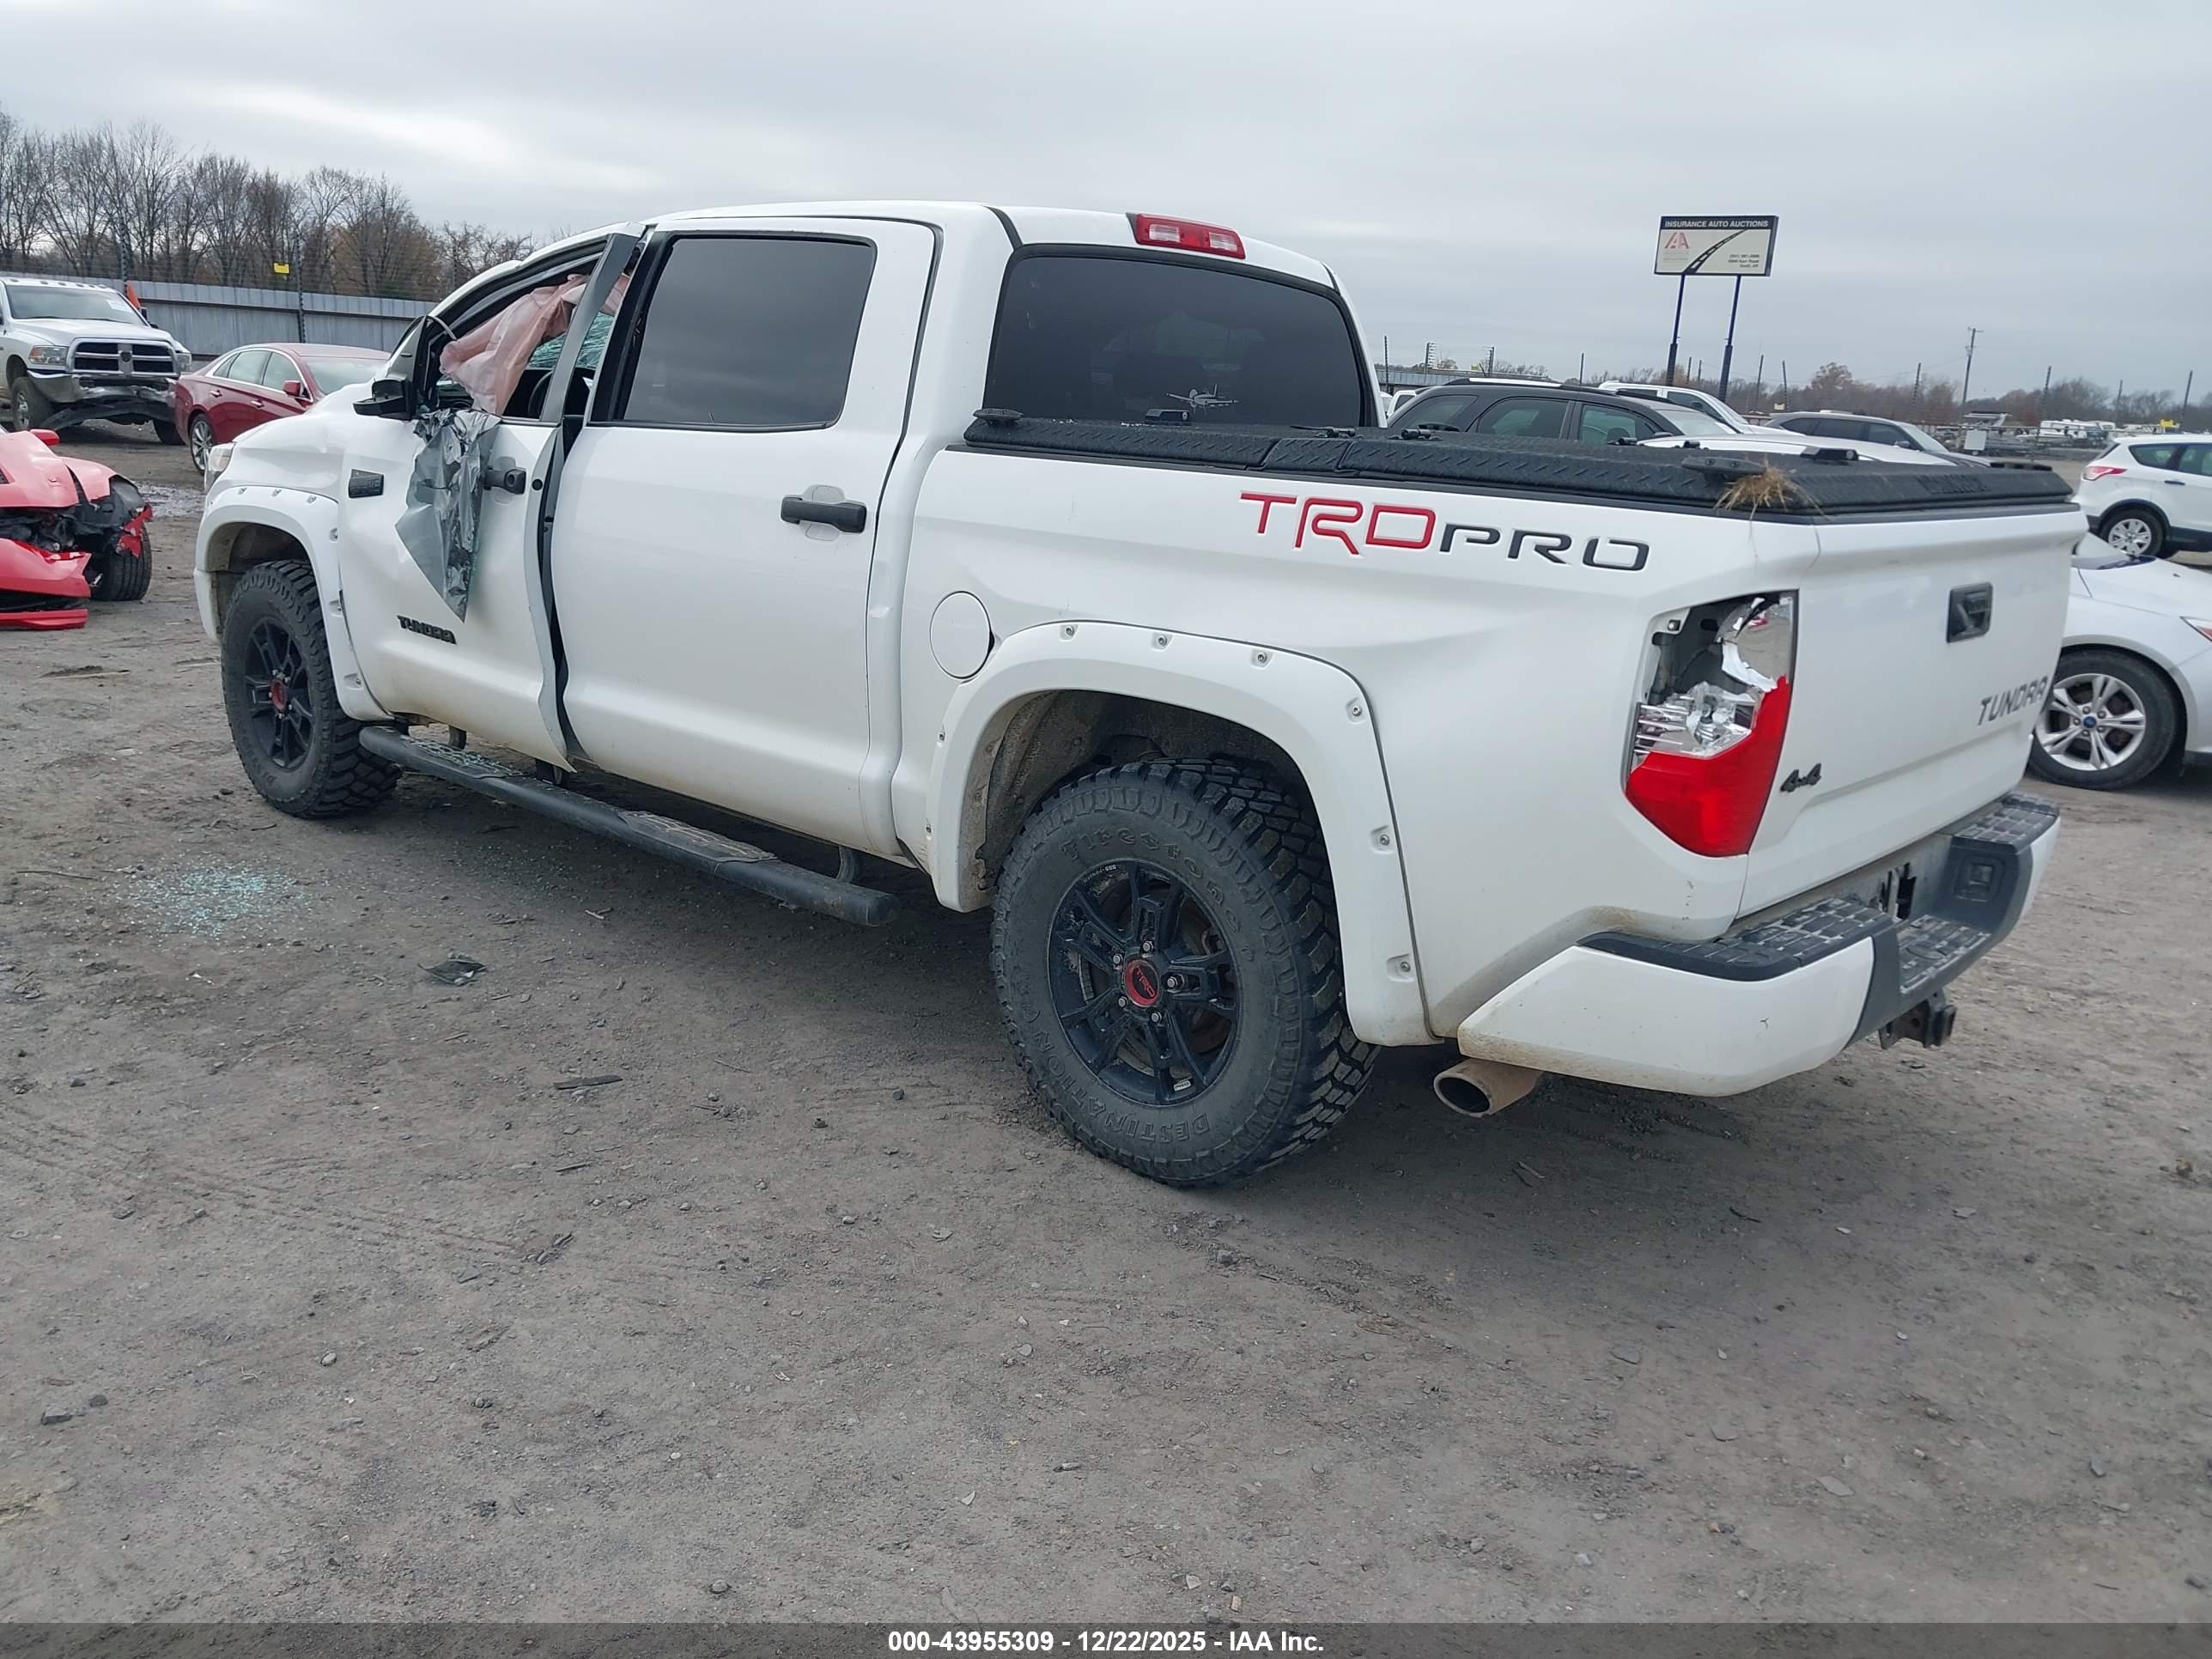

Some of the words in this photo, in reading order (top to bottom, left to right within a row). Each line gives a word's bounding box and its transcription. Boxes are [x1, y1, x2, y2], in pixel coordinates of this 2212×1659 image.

[1240, 492, 1436, 556] TRD
[1440, 522, 1650, 572] PRO
[1978, 676, 2049, 726] TUNDRA
